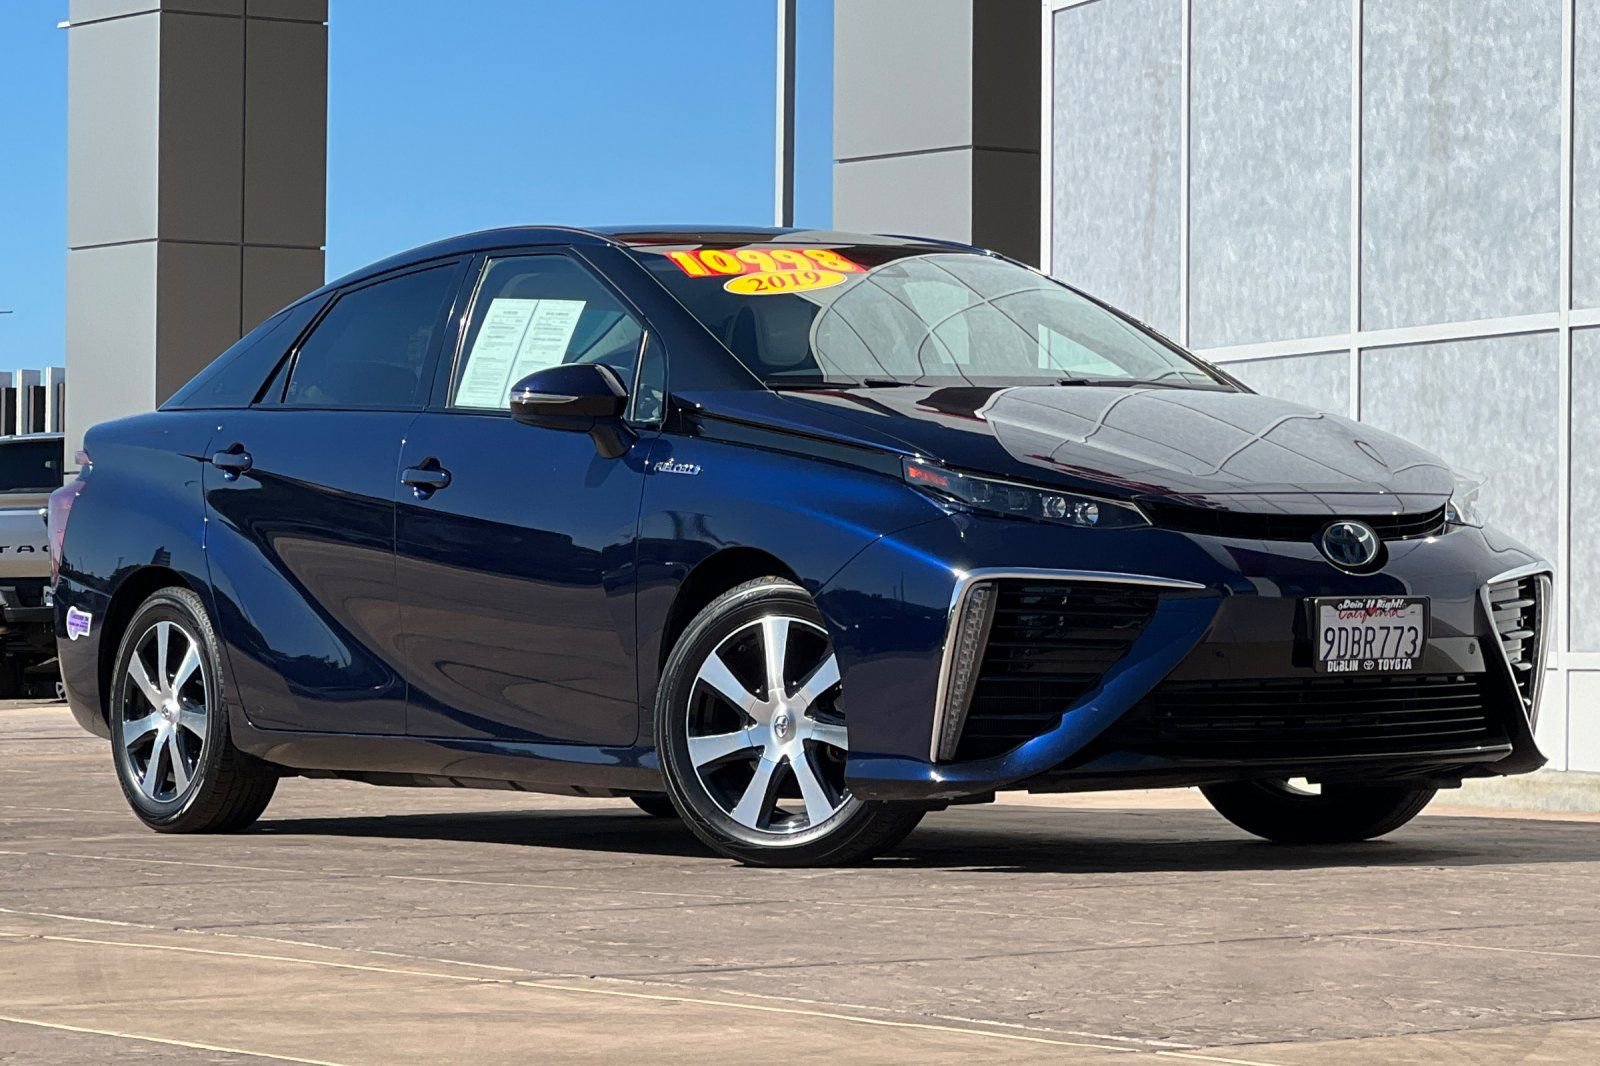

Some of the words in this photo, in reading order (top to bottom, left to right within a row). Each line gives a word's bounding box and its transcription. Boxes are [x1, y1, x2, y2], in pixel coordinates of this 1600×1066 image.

[670, 249, 855, 276] 10998
[747, 269, 822, 292] 2019
[1324, 627, 1418, 660] 9DBR773
[1327, 660, 1359, 672] DUBLIN
[1377, 659, 1412, 671] TOYOTA
